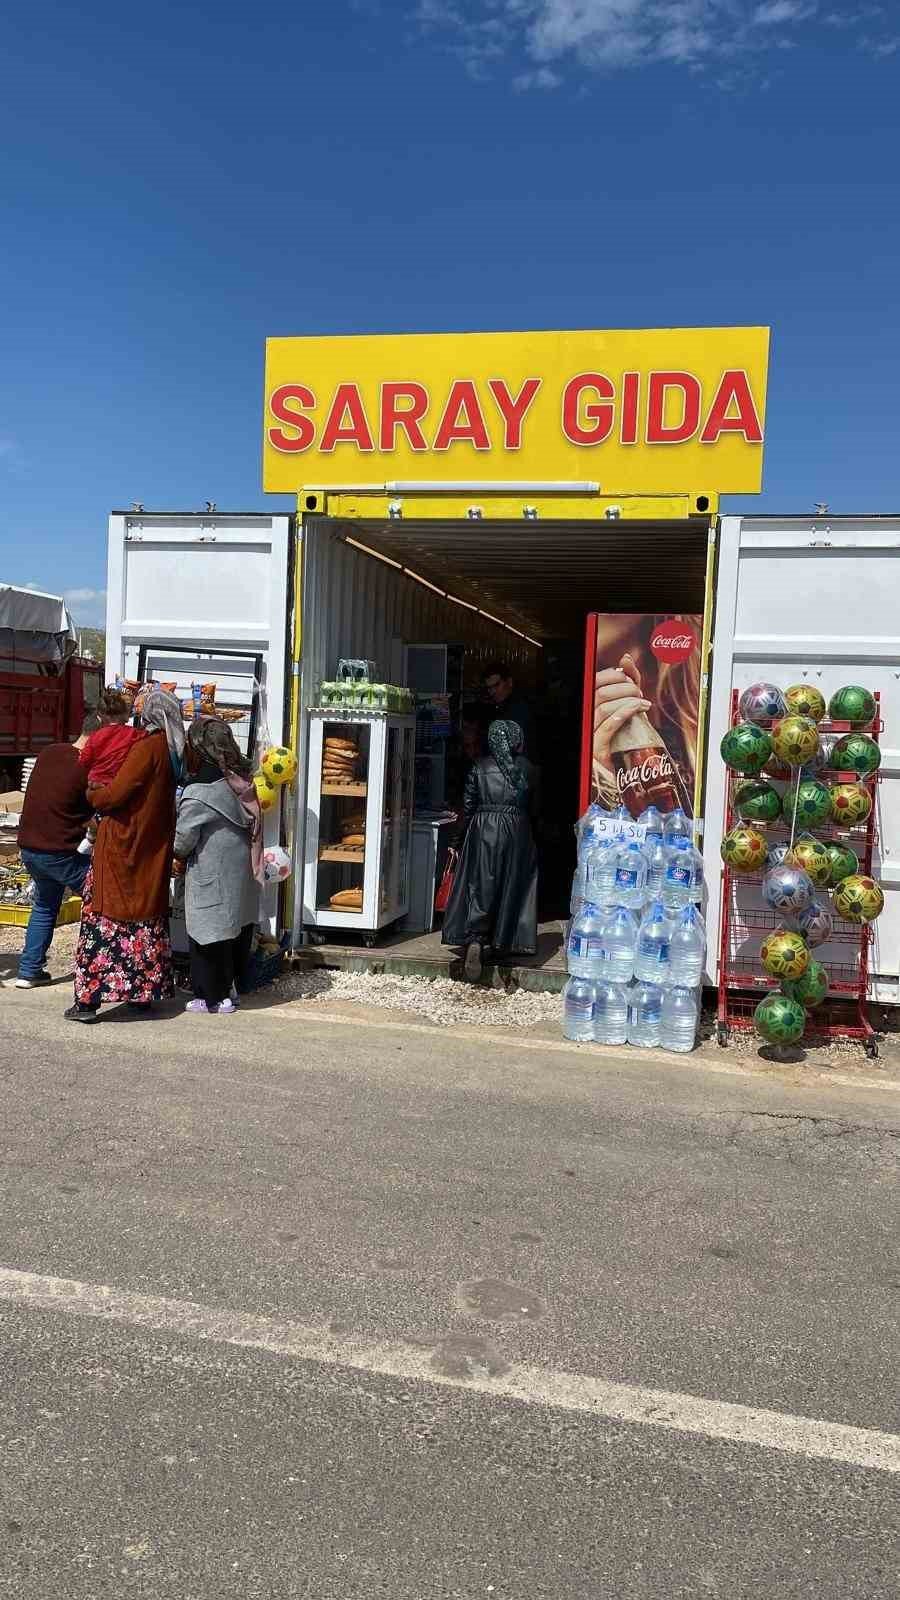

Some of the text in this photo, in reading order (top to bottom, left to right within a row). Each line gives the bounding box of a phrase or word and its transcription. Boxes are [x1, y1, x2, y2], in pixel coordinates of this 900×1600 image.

[268, 369, 764, 453] SARAY GIDA
[652, 634, 692, 649] Coca-Cola
[617, 753, 673, 794] Coca-Cola
